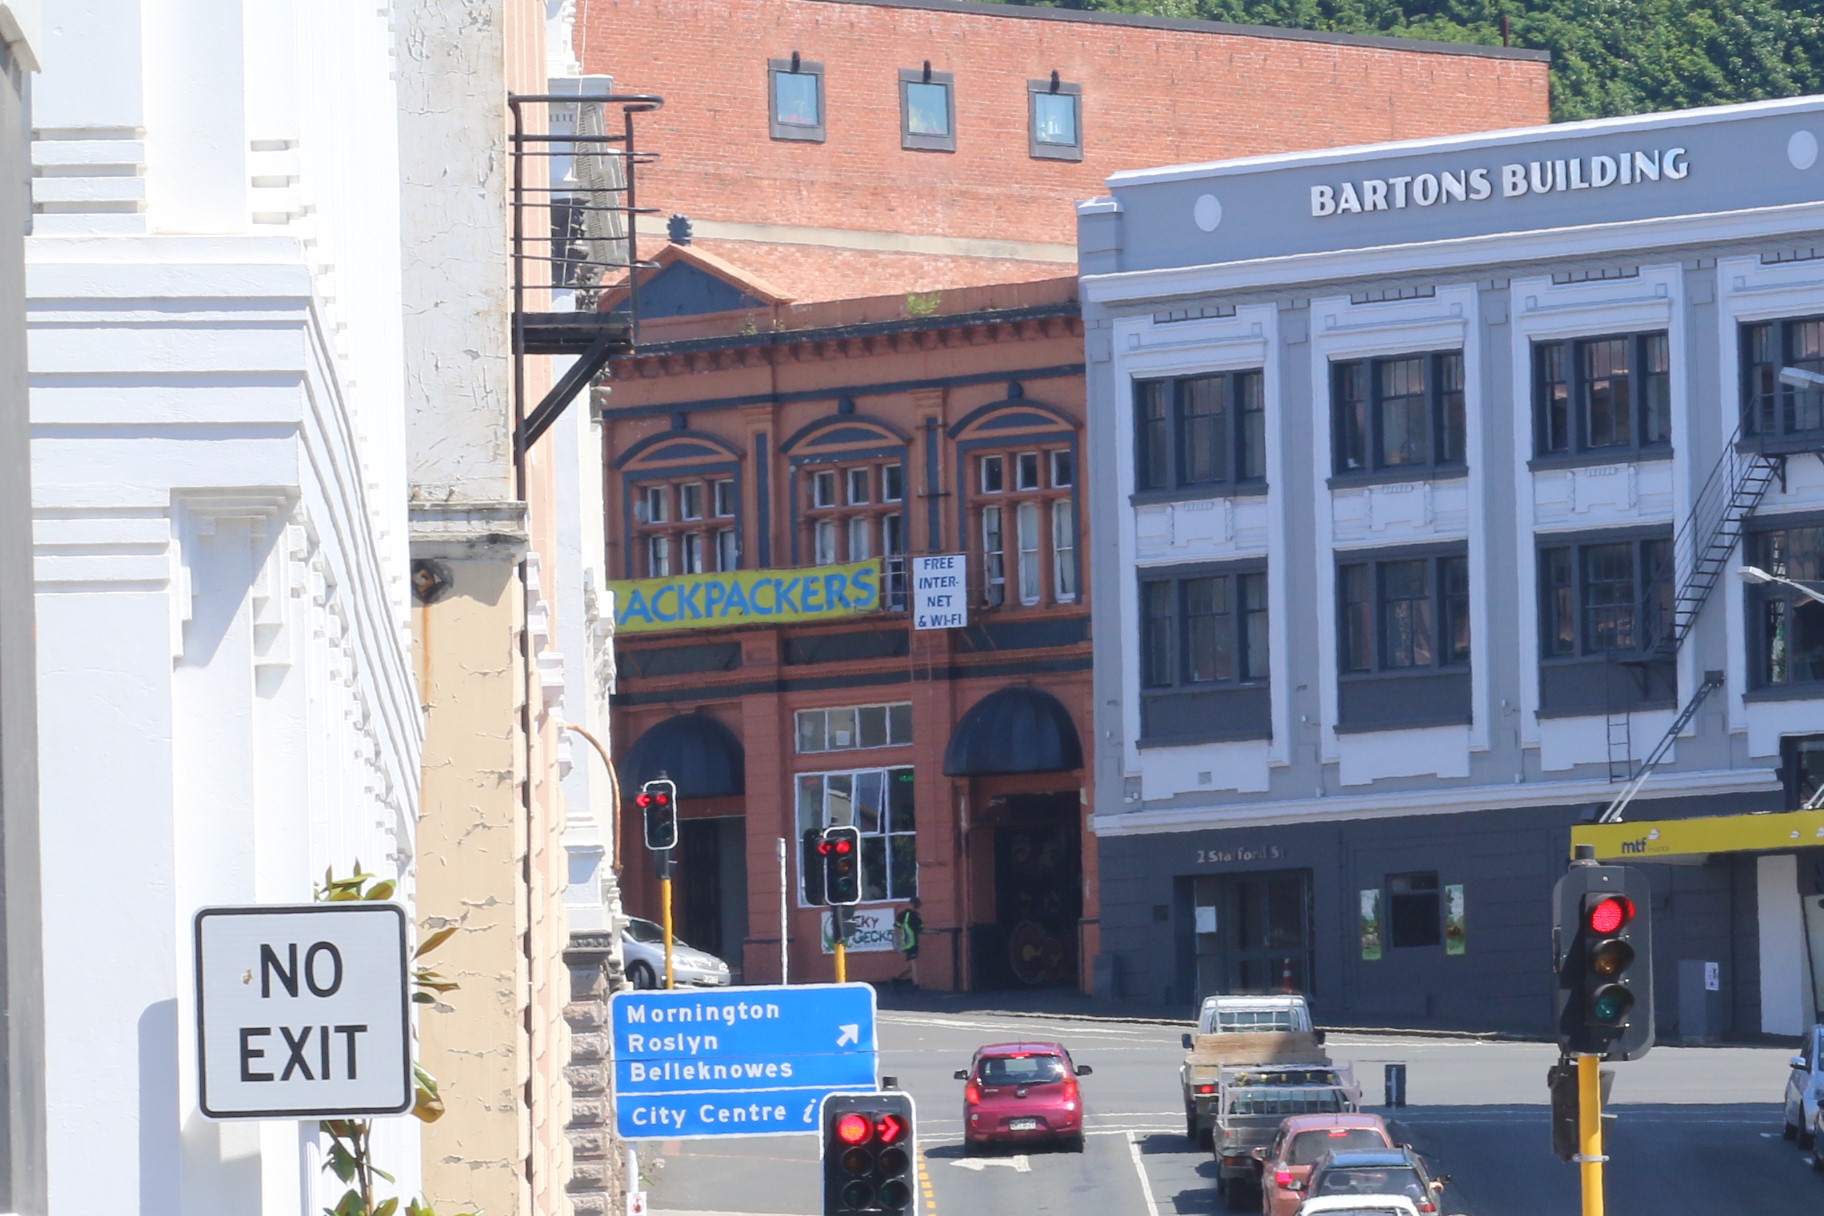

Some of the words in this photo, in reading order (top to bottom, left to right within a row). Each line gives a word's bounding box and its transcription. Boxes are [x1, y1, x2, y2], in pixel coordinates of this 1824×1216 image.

[1311, 168, 1491, 217] BARTONS
[1502, 147, 1690, 198] BUILDING
[924, 557, 954, 570] FREE
[919, 576, 959, 589] INTER-
[613, 568, 876, 626] ACKPACKERS
[927, 595, 952, 607] NET
[918, 615, 927, 627] &
[1197, 850, 1205, 863] 2
[1208, 846, 1267, 862] Staford
[1622, 837, 1647, 854] mtf
[260, 941, 343, 998] NO
[627, 1001, 780, 1026] Mornington
[239, 1025, 368, 1082] EXIT
[628, 1033, 718, 1055] Roslyn
[630, 1061, 793, 1082] Belleknowes
[632, 1106, 687, 1129] City
[700, 1104, 787, 1122] Centre
